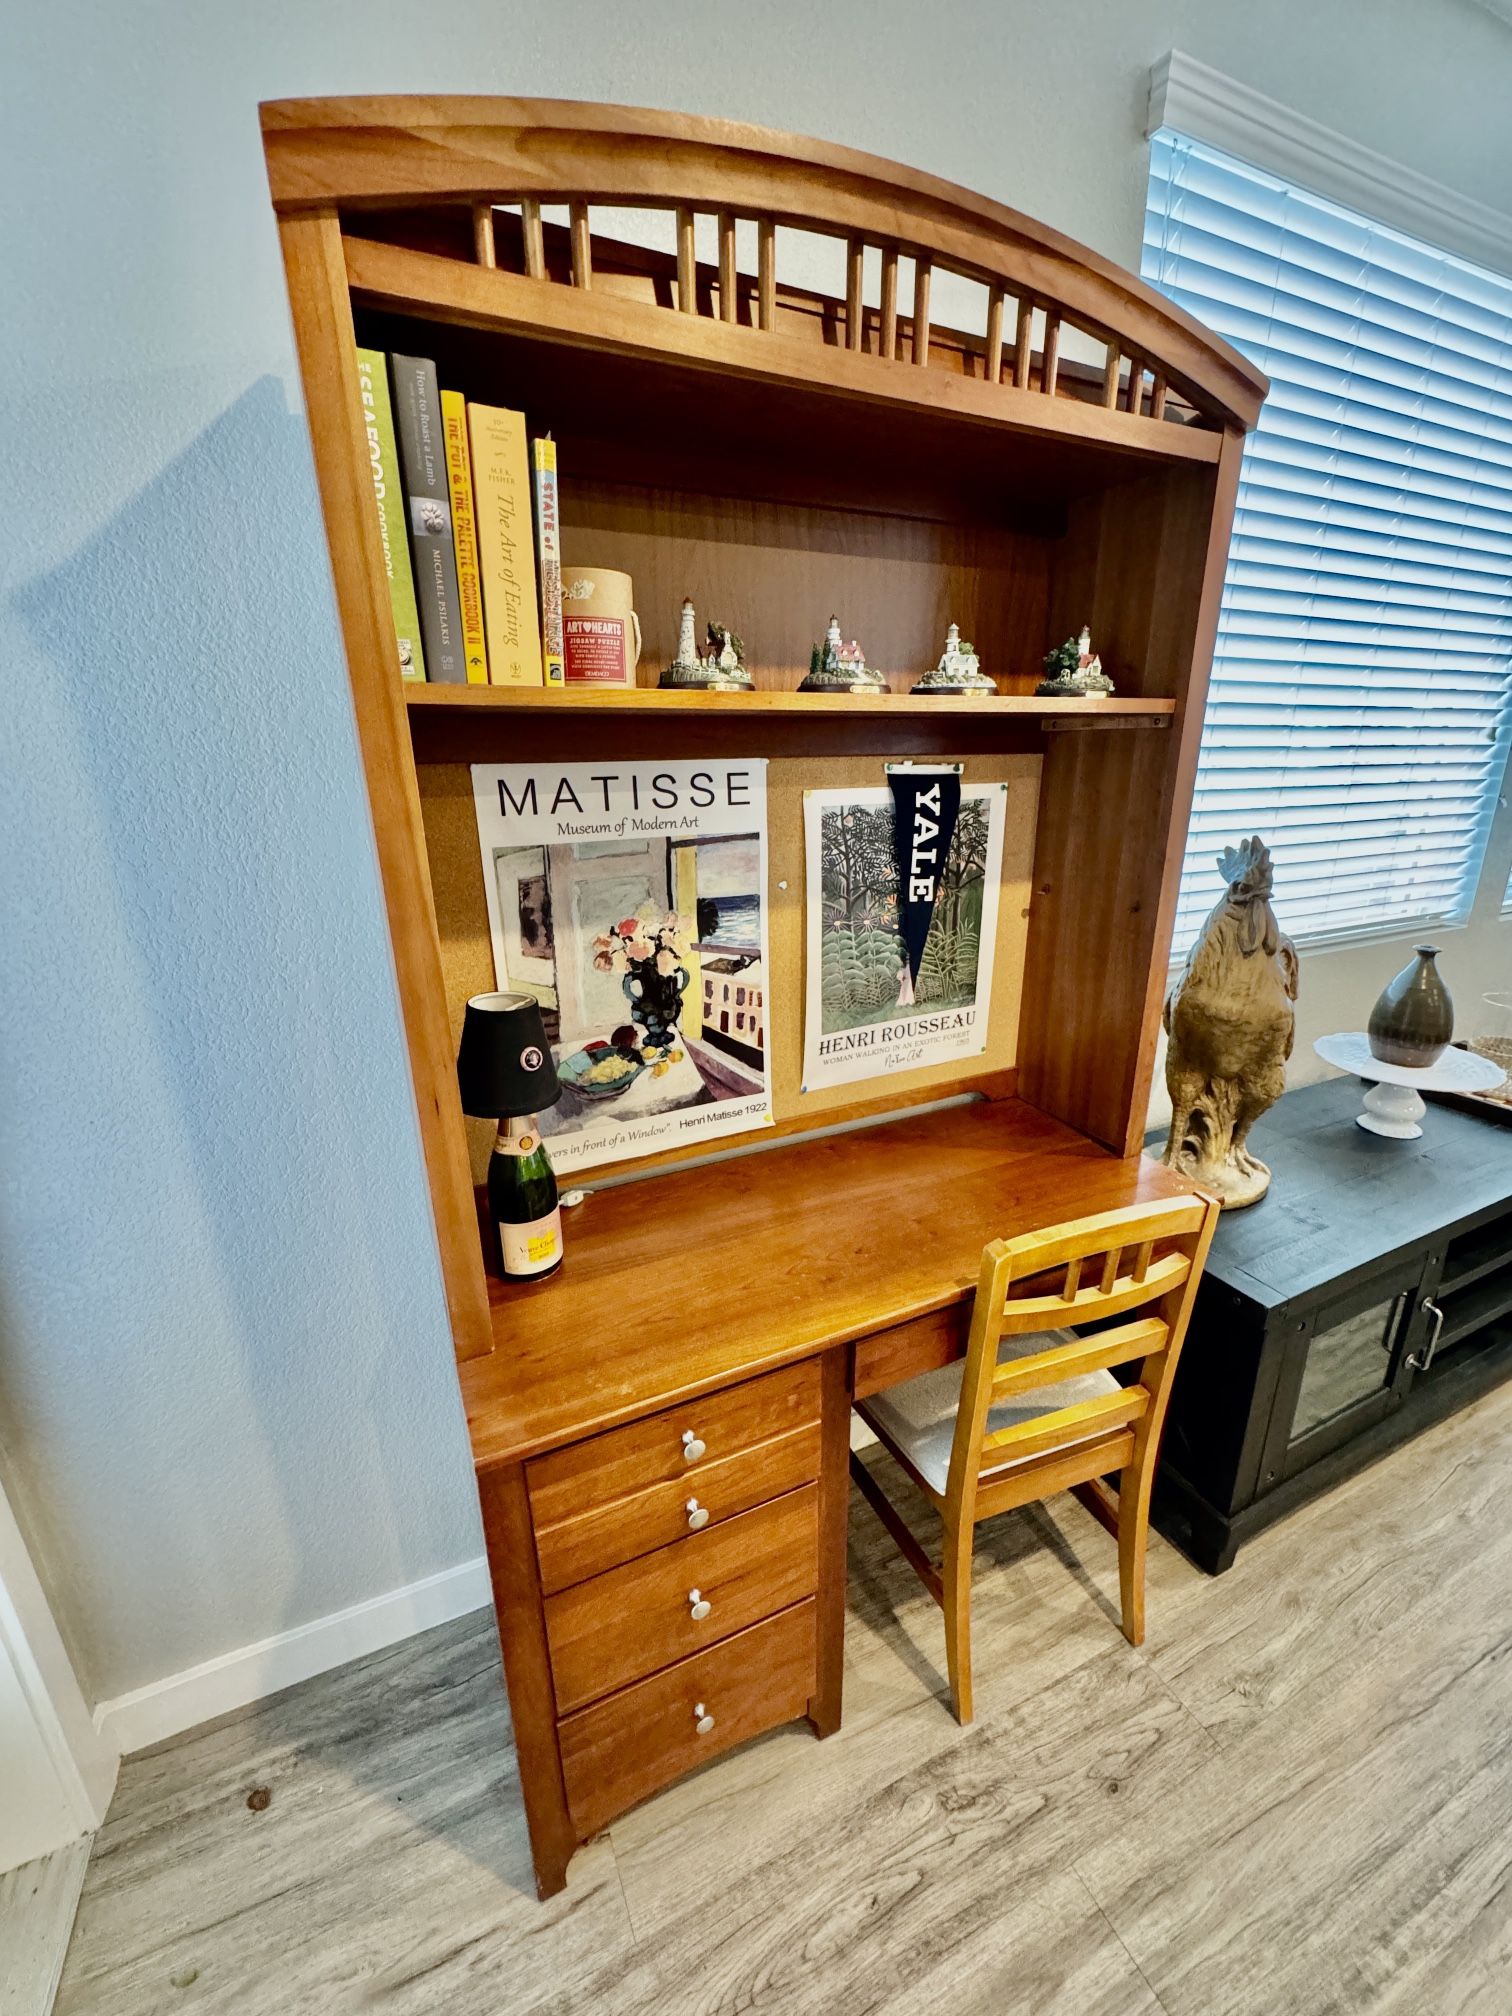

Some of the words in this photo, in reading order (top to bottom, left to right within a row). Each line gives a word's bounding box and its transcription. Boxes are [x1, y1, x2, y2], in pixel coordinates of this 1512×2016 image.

[415, 369, 426, 396] How
[418, 400, 428, 414] to
[419, 414, 432, 445] Roast
[447, 417, 464, 442] THE
[423, 446, 431, 456] a
[450, 444, 467, 472] POT
[424, 455, 437, 487] Lamb
[453, 473, 468, 486] &
[488, 474, 516, 485] FISHER
[453, 490, 471, 513] THE
[497, 495, 516, 530] The
[543, 481, 555, 532] STATE
[456, 517, 475, 570] PALETTE
[500, 532, 518, 566] Art
[544, 536, 554, 551] of
[432, 549, 447, 597] MICHAEL
[497, 567, 522, 592] of
[462, 572, 481, 634] COOKBOOK
[437, 600, 450, 646] PSILAKIS
[502, 589, 524, 648] Eating
[566, 621, 583, 634] ART
[591, 621, 622, 636] HEARTS
[467, 636, 481, 645] II
[569, 637, 595, 645] JIGSAW
[597, 638, 621, 646] PUZZLE
[497, 772, 751, 817] MATISSE
[556, 820, 612, 836] Museum
[614, 817, 628, 837] of
[631, 815, 677, 832] Modern
[679, 815, 700, 829] Art
[908, 783, 941, 903] YALE
[818, 1029, 875, 1056] HENRI
[882, 1010, 977, 1043] ROUSSEAU
[823, 1054, 854, 1066] WOMAN
[856, 1046, 891, 1059] WALKING
[892, 1044, 901, 1053] IN
[902, 1041, 913, 1050] AN
[914, 1036, 941, 1048] EXOTIC
[942, 1030, 971, 1041] FOREST
[679, 1115, 705, 1129] Henri
[706, 1108, 743, 1123] Matisse
[744, 1102, 768, 1115] 1922
[570, 1144, 581, 1155] in
[579, 1136, 607, 1156] front
[607, 1132, 622, 1149] of
[620, 1135, 627, 1143] a
